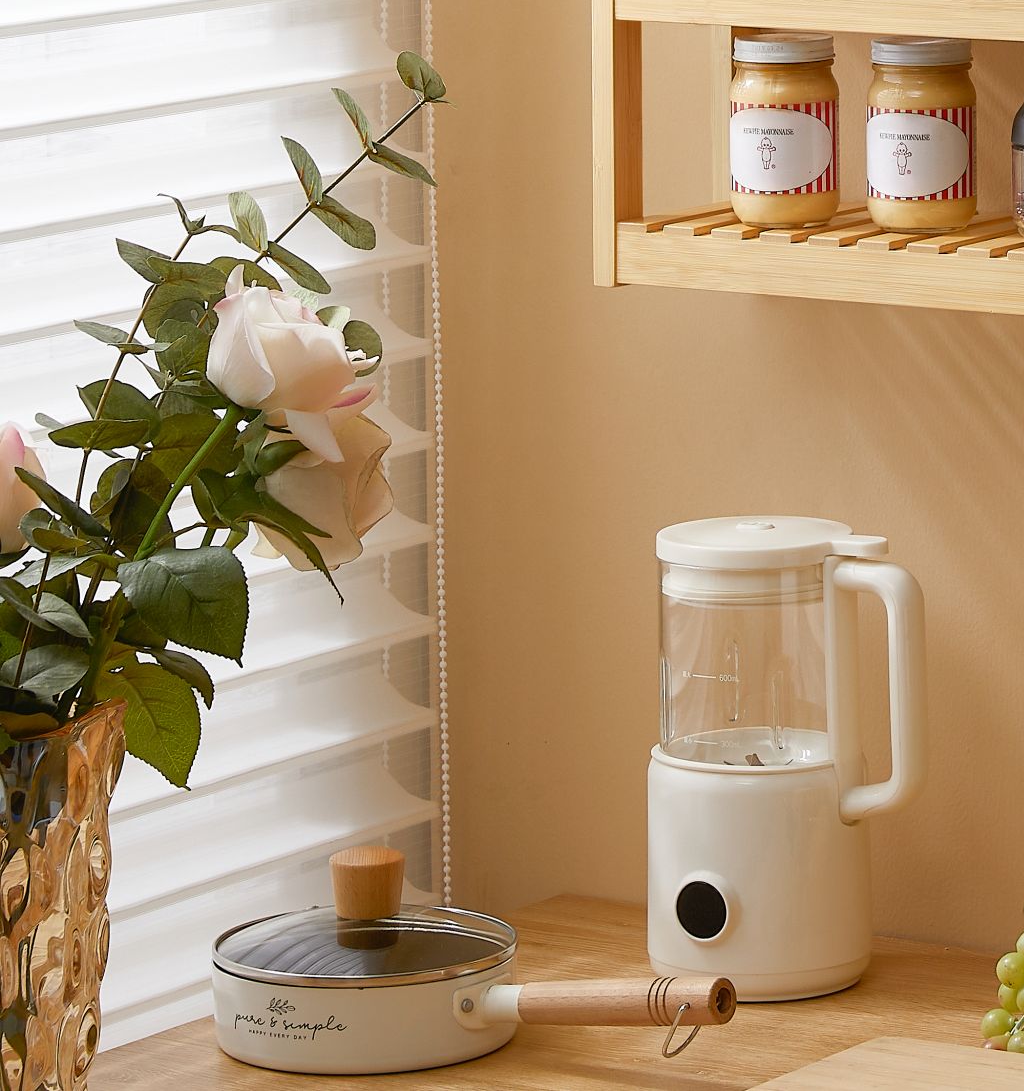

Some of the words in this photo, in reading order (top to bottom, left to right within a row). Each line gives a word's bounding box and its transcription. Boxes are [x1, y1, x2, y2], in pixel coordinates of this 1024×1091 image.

[761, 128, 795, 136] MAYONNAISE
[896, 133, 931, 141] MAYONNAISE
[234, 1013, 266, 1029] pure
[270, 1016, 278, 1028] &
[282, 1015, 348, 1040] simple
